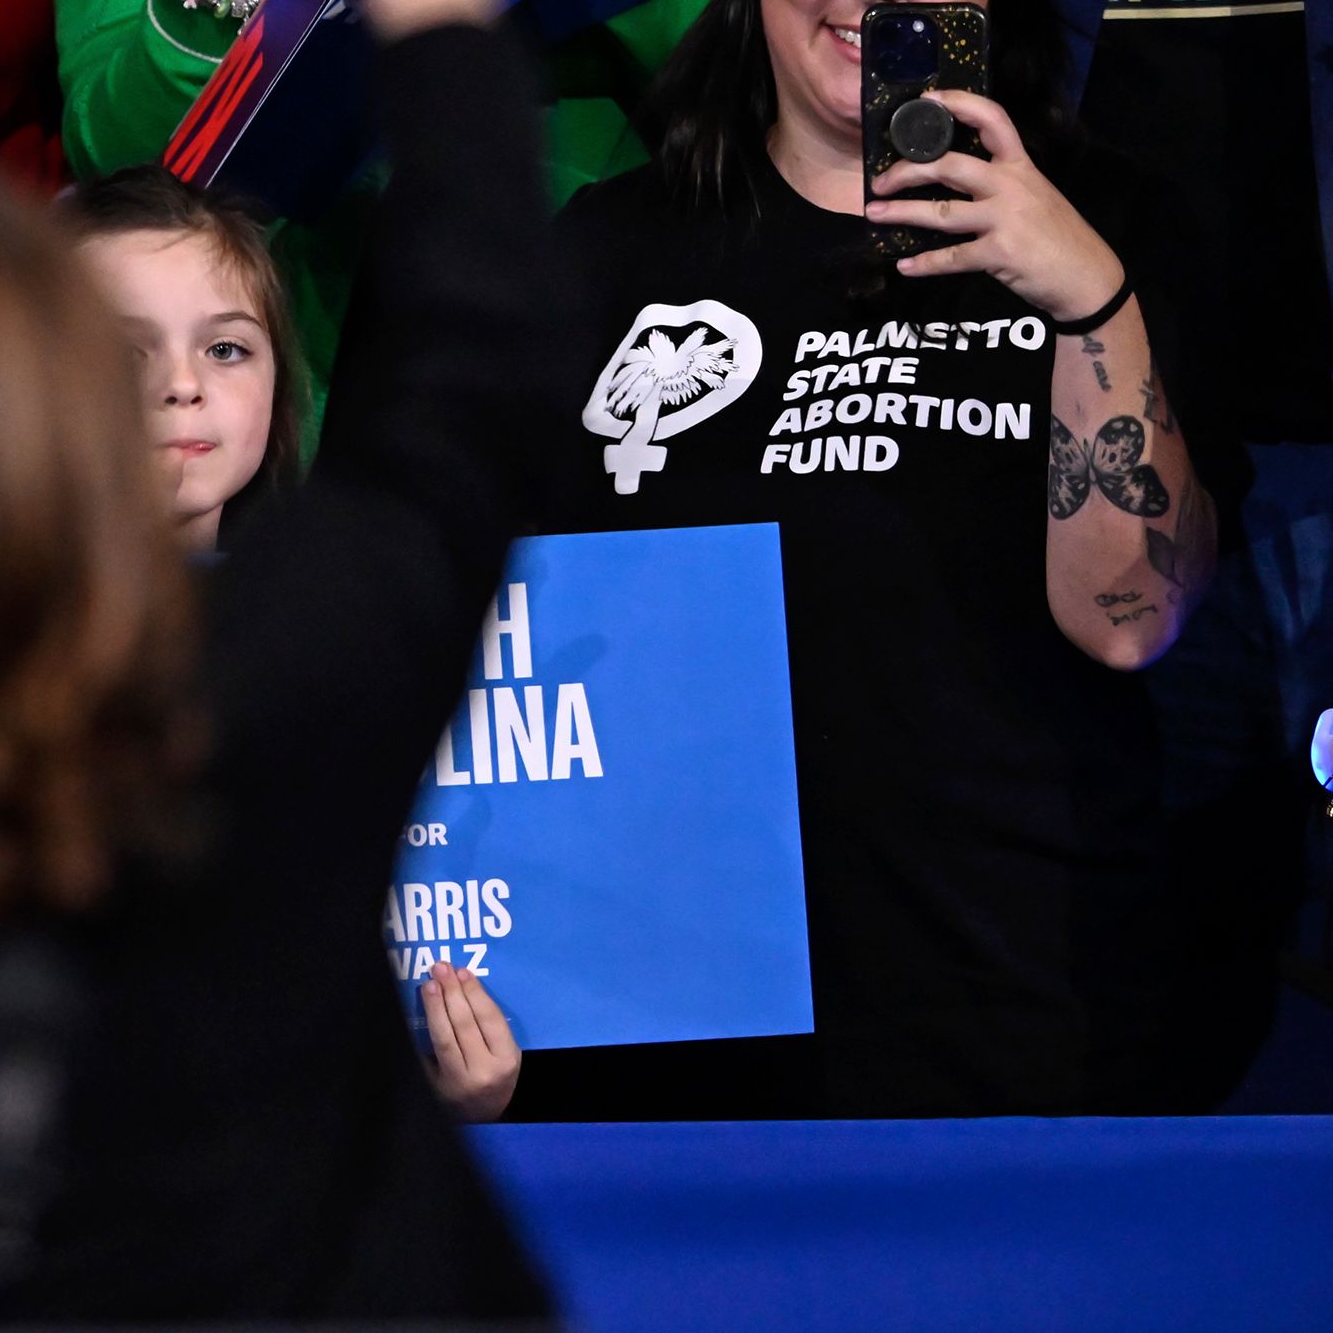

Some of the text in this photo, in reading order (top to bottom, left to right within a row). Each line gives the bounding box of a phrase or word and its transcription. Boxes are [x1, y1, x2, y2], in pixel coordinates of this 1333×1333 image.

[794, 316, 1046, 363] PALMETTO
[783, 356, 920, 401] STATE
[768, 392, 1031, 440] ABORTION
[760, 435, 900, 474] FUND
[403, 822, 448, 848] OR
